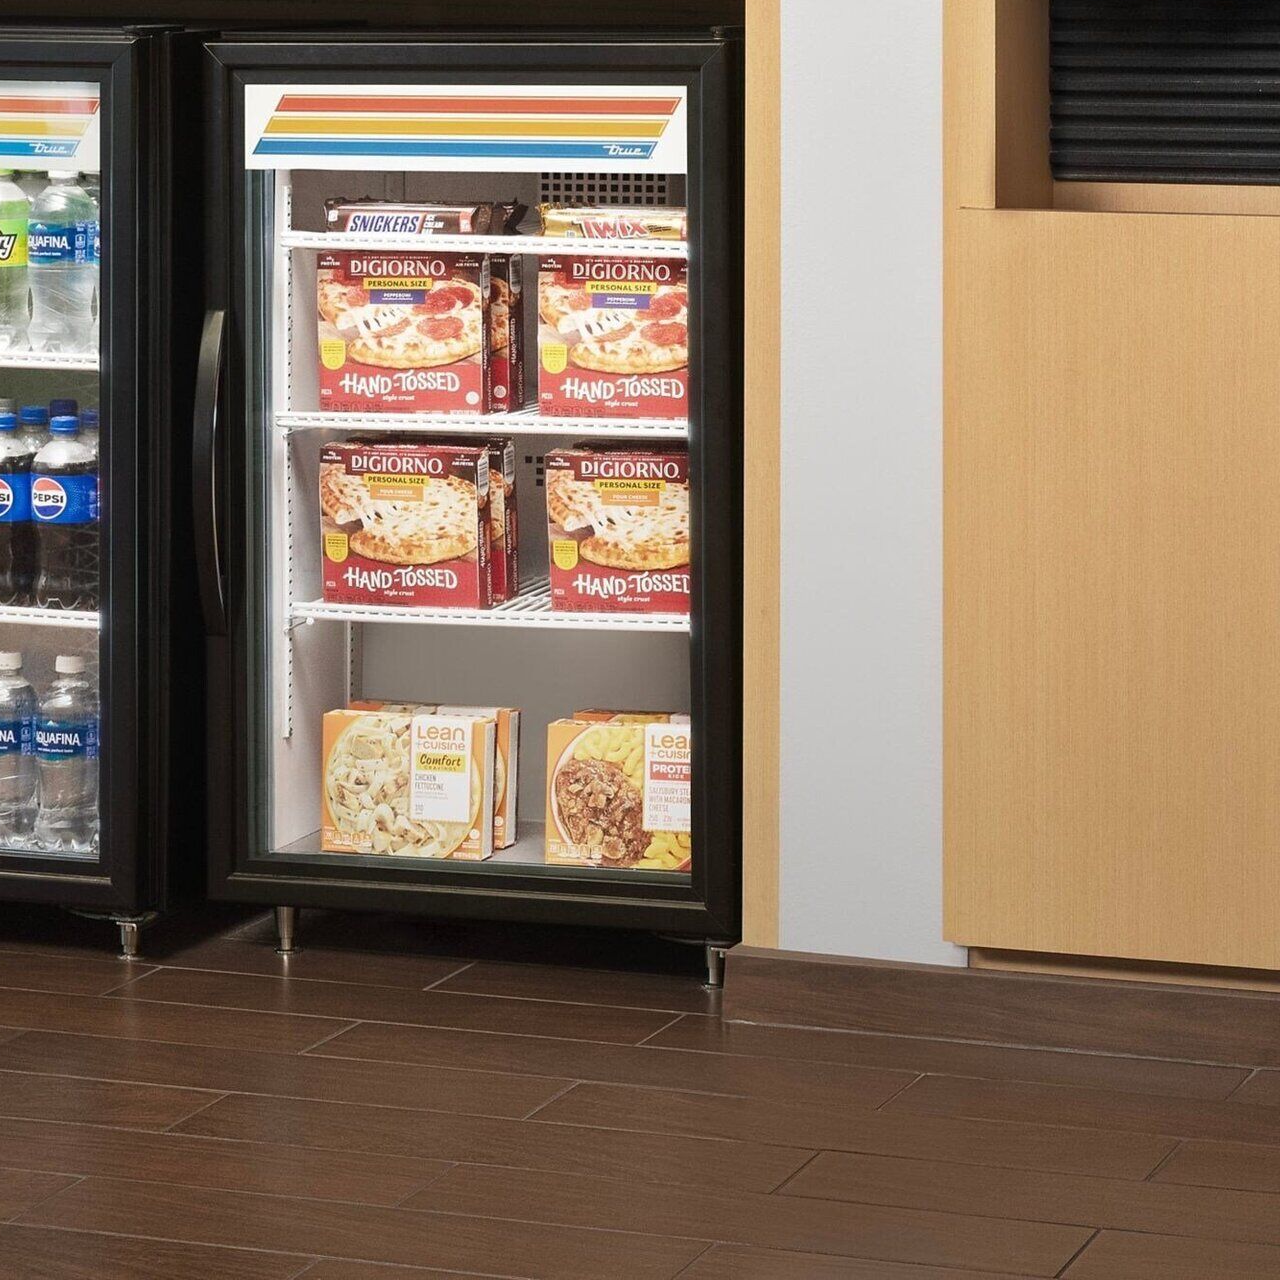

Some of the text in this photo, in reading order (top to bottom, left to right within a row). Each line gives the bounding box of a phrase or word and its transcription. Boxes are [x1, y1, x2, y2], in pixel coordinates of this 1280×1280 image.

[350, 214, 419, 233] SNICKERS
[581, 218, 649, 238] TWIX
[28, 235, 70, 250] QUAFINA
[339, 370, 460, 397] HAND-TOSSED
[560, 375, 684, 403] HAND-TOSSED
[599, 481, 642, 489] PERSONAL
[33, 492, 64, 503] PEPSI
[343, 566, 458, 591] HAND-TOSSED
[417, 725, 465, 740] Lean
[651, 735, 691, 750] Lea
[420, 753, 462, 767] Comfort
[652, 764, 691, 774] PROTE
[415, 773, 437, 781] CHICKEN
